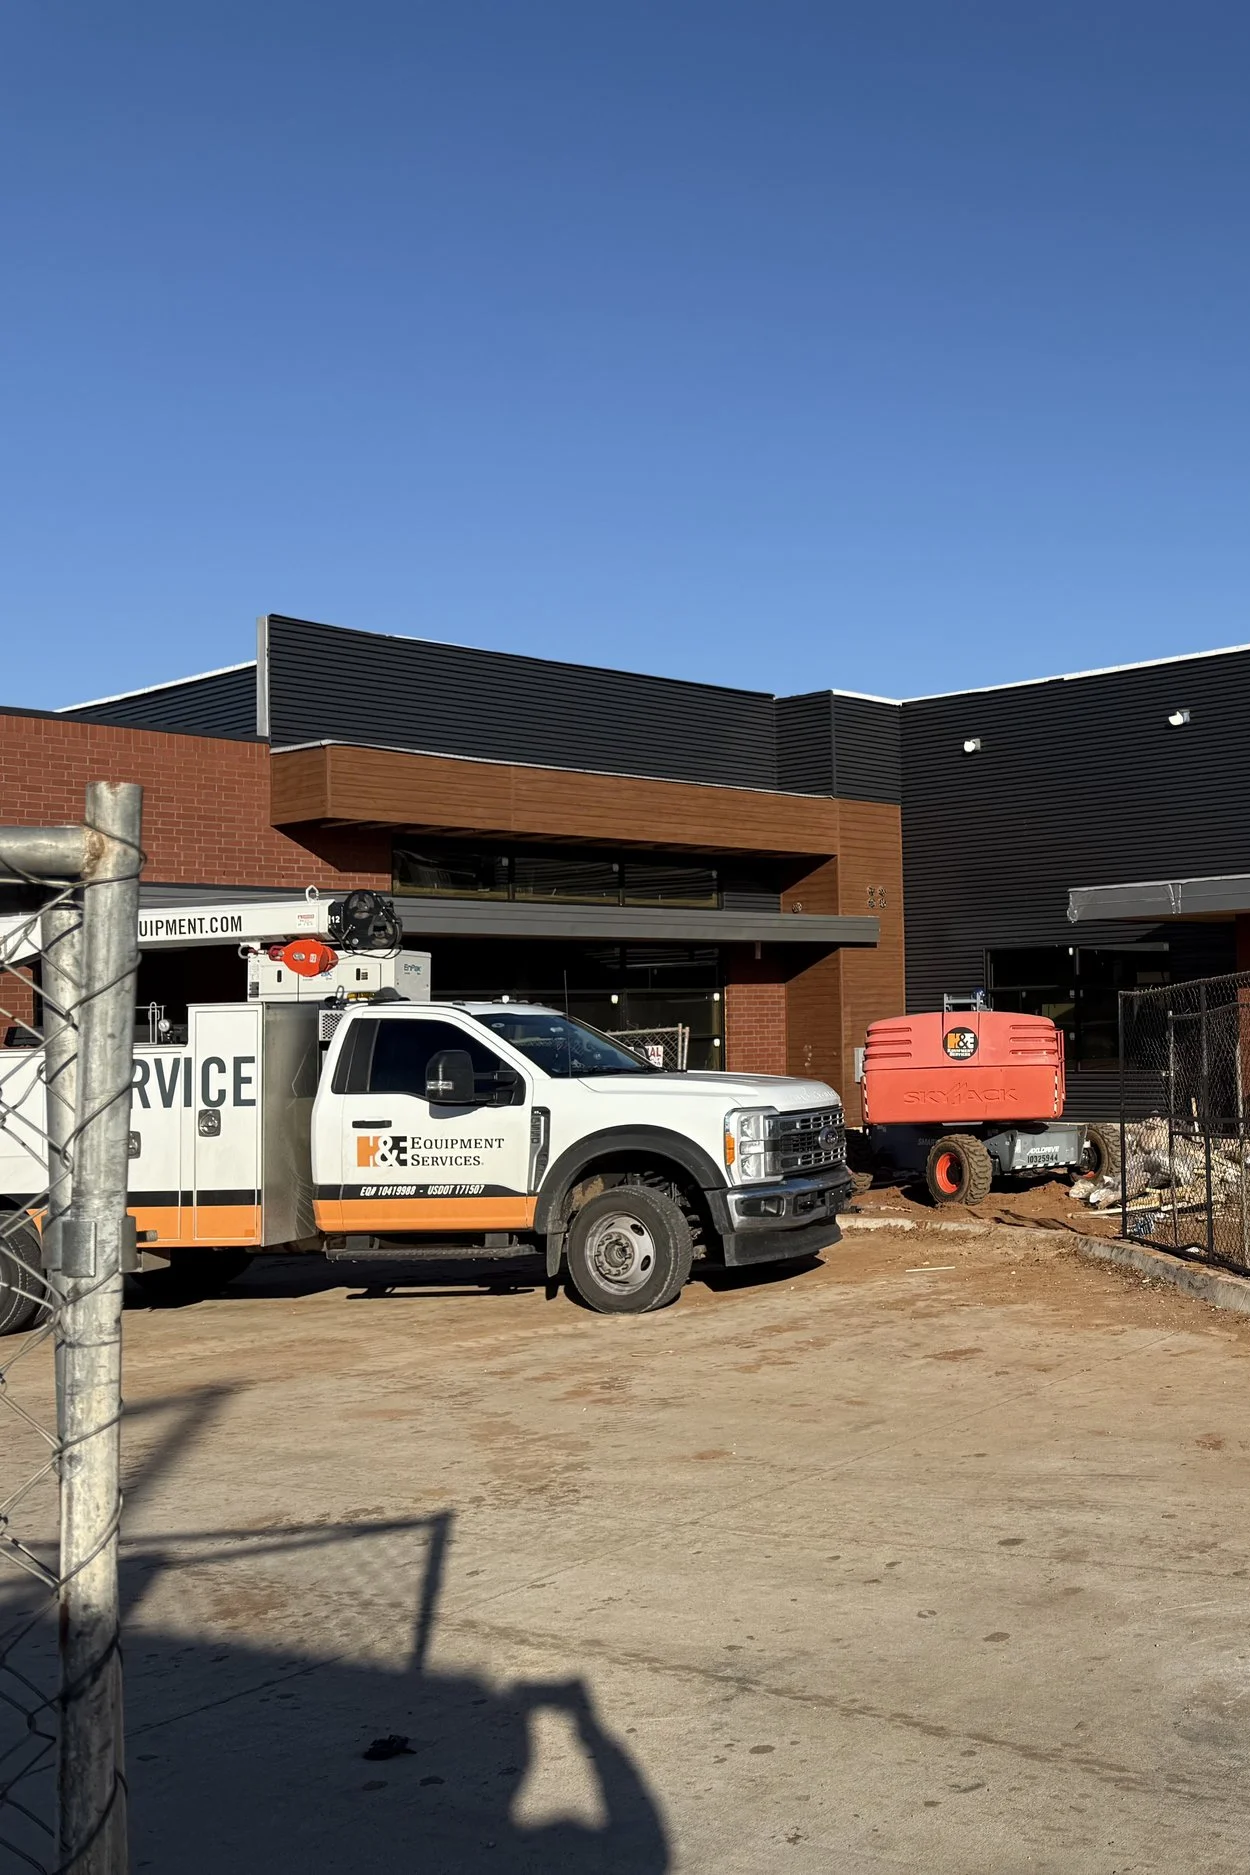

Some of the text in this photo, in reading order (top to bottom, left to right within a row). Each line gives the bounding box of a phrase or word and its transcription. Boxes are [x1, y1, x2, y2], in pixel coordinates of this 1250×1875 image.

[138, 915, 243, 937] UIPMENT.COM
[947, 1033, 974, 1049] H&E
[131, 1056, 256, 1109] RVICE
[904, 1082, 1018, 1105] SKYJACK
[357, 1136, 408, 1167] H&E
[410, 1136, 505, 1150] EQUIPMENT
[1027, 1154, 1058, 1164] 10325944
[360, 1186, 377, 1196] EQ#
[427, 1185, 455, 1195] USDOT
[455, 1184, 485, 1195] 171507
